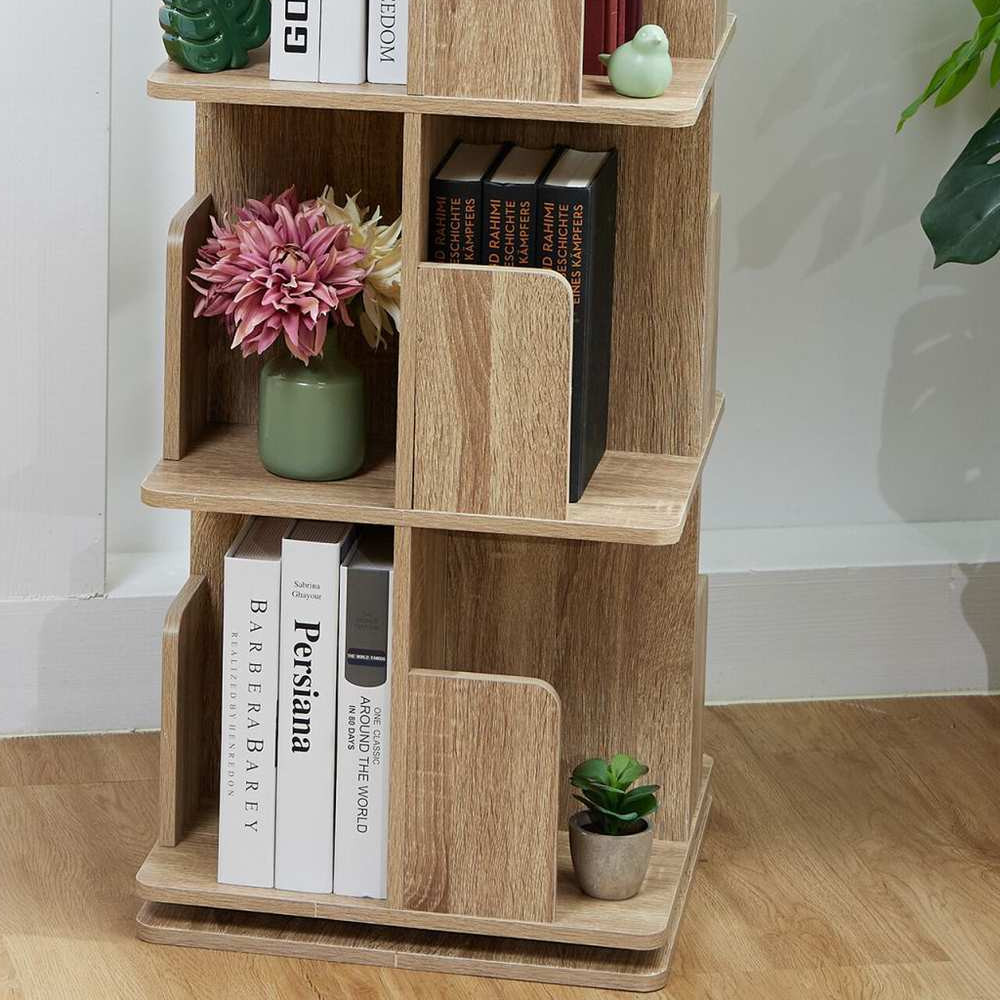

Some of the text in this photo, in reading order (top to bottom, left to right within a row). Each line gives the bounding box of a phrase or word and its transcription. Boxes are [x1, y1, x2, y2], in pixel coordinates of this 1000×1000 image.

[434, 196, 446, 245] RAHIMI
[450, 197, 461, 264] ESCHICHTE
[489, 199, 502, 249] RAHIMI
[504, 199, 516, 267] ESCHICHTE
[542, 202, 555, 252] RAHIMI
[570, 204, 584, 268] KÄMPFERS
[230, 632, 238, 699] REALIZED
[292, 619, 321, 753] Persiana
[229, 703, 236, 719] BY
[244, 599, 268, 832] BARBERA BAREY
[347, 727, 356, 751] DAYS
[348, 704, 356, 714] IN
[372, 706, 382, 765] ONE CLASSIC
[356, 695, 371, 834] AROUND THE WORLD
